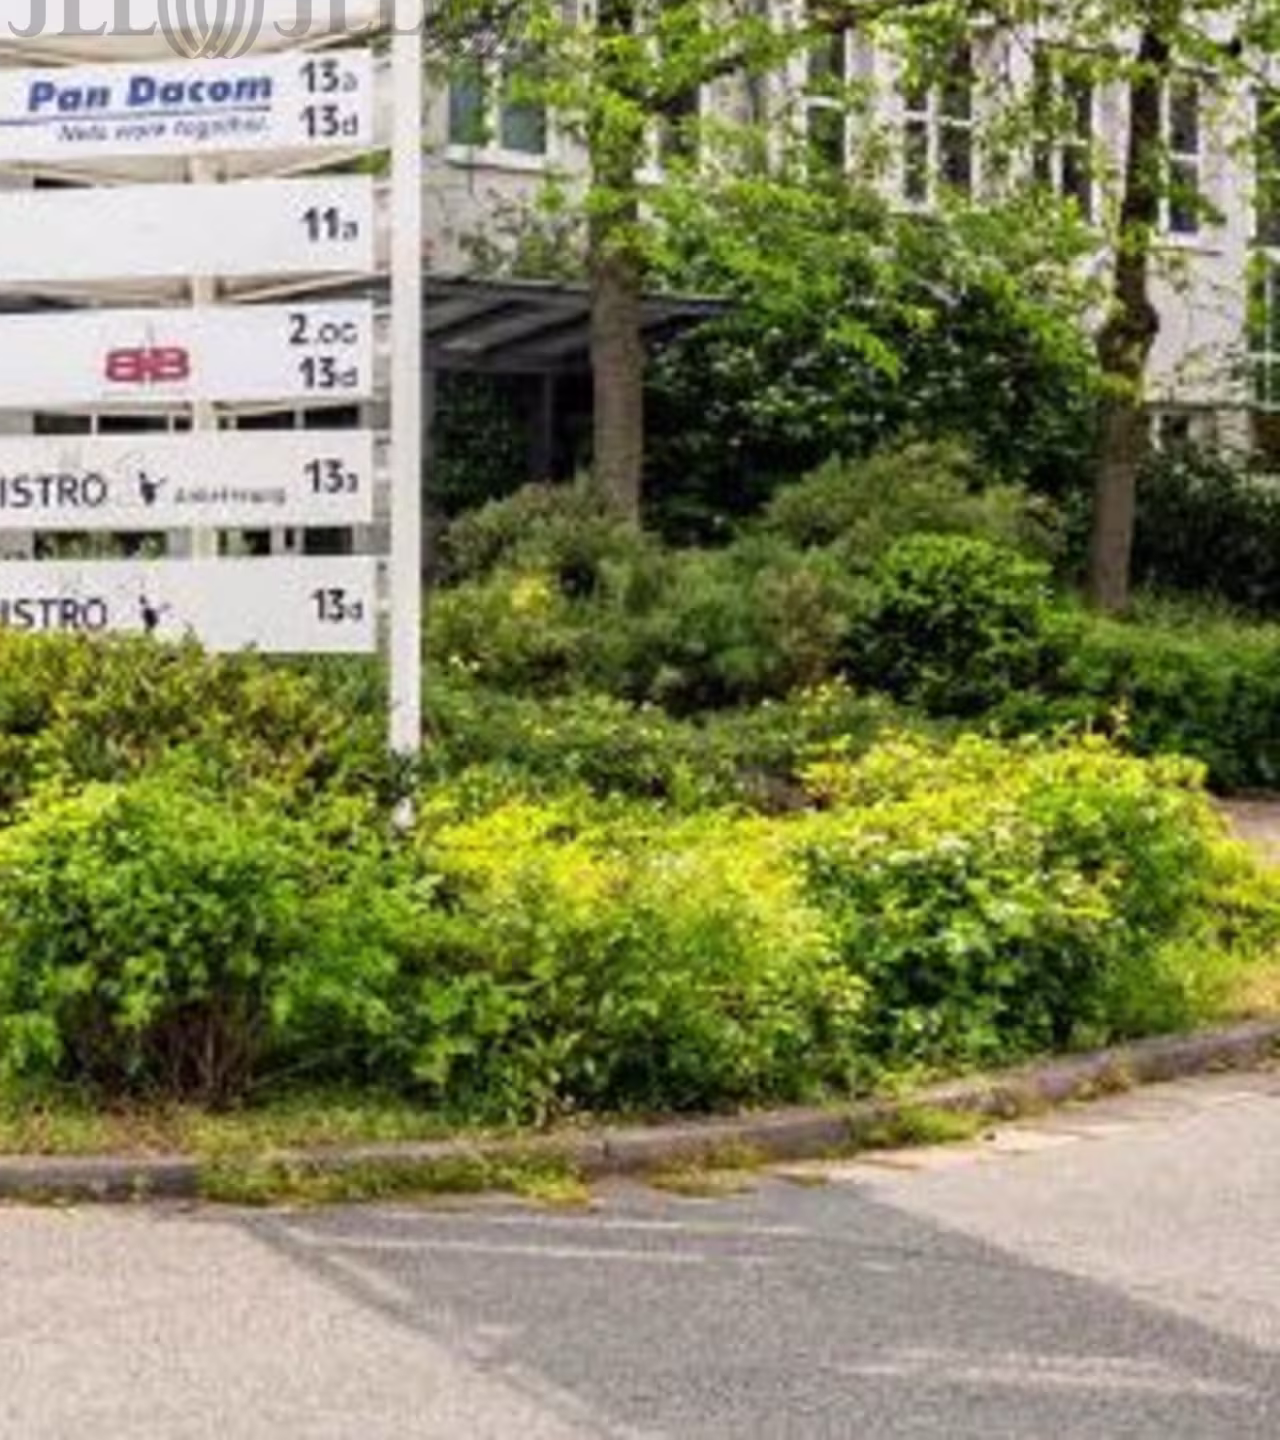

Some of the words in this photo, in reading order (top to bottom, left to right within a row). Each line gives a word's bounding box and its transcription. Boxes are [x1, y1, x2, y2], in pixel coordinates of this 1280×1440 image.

[299, 59, 358, 93] 13a
[28, 80, 111, 112] Pan
[127, 75, 273, 107] Dacom
[299, 105, 358, 137] 13d
[301, 206, 358, 242] 11a
[298, 357, 358, 388] 13d
